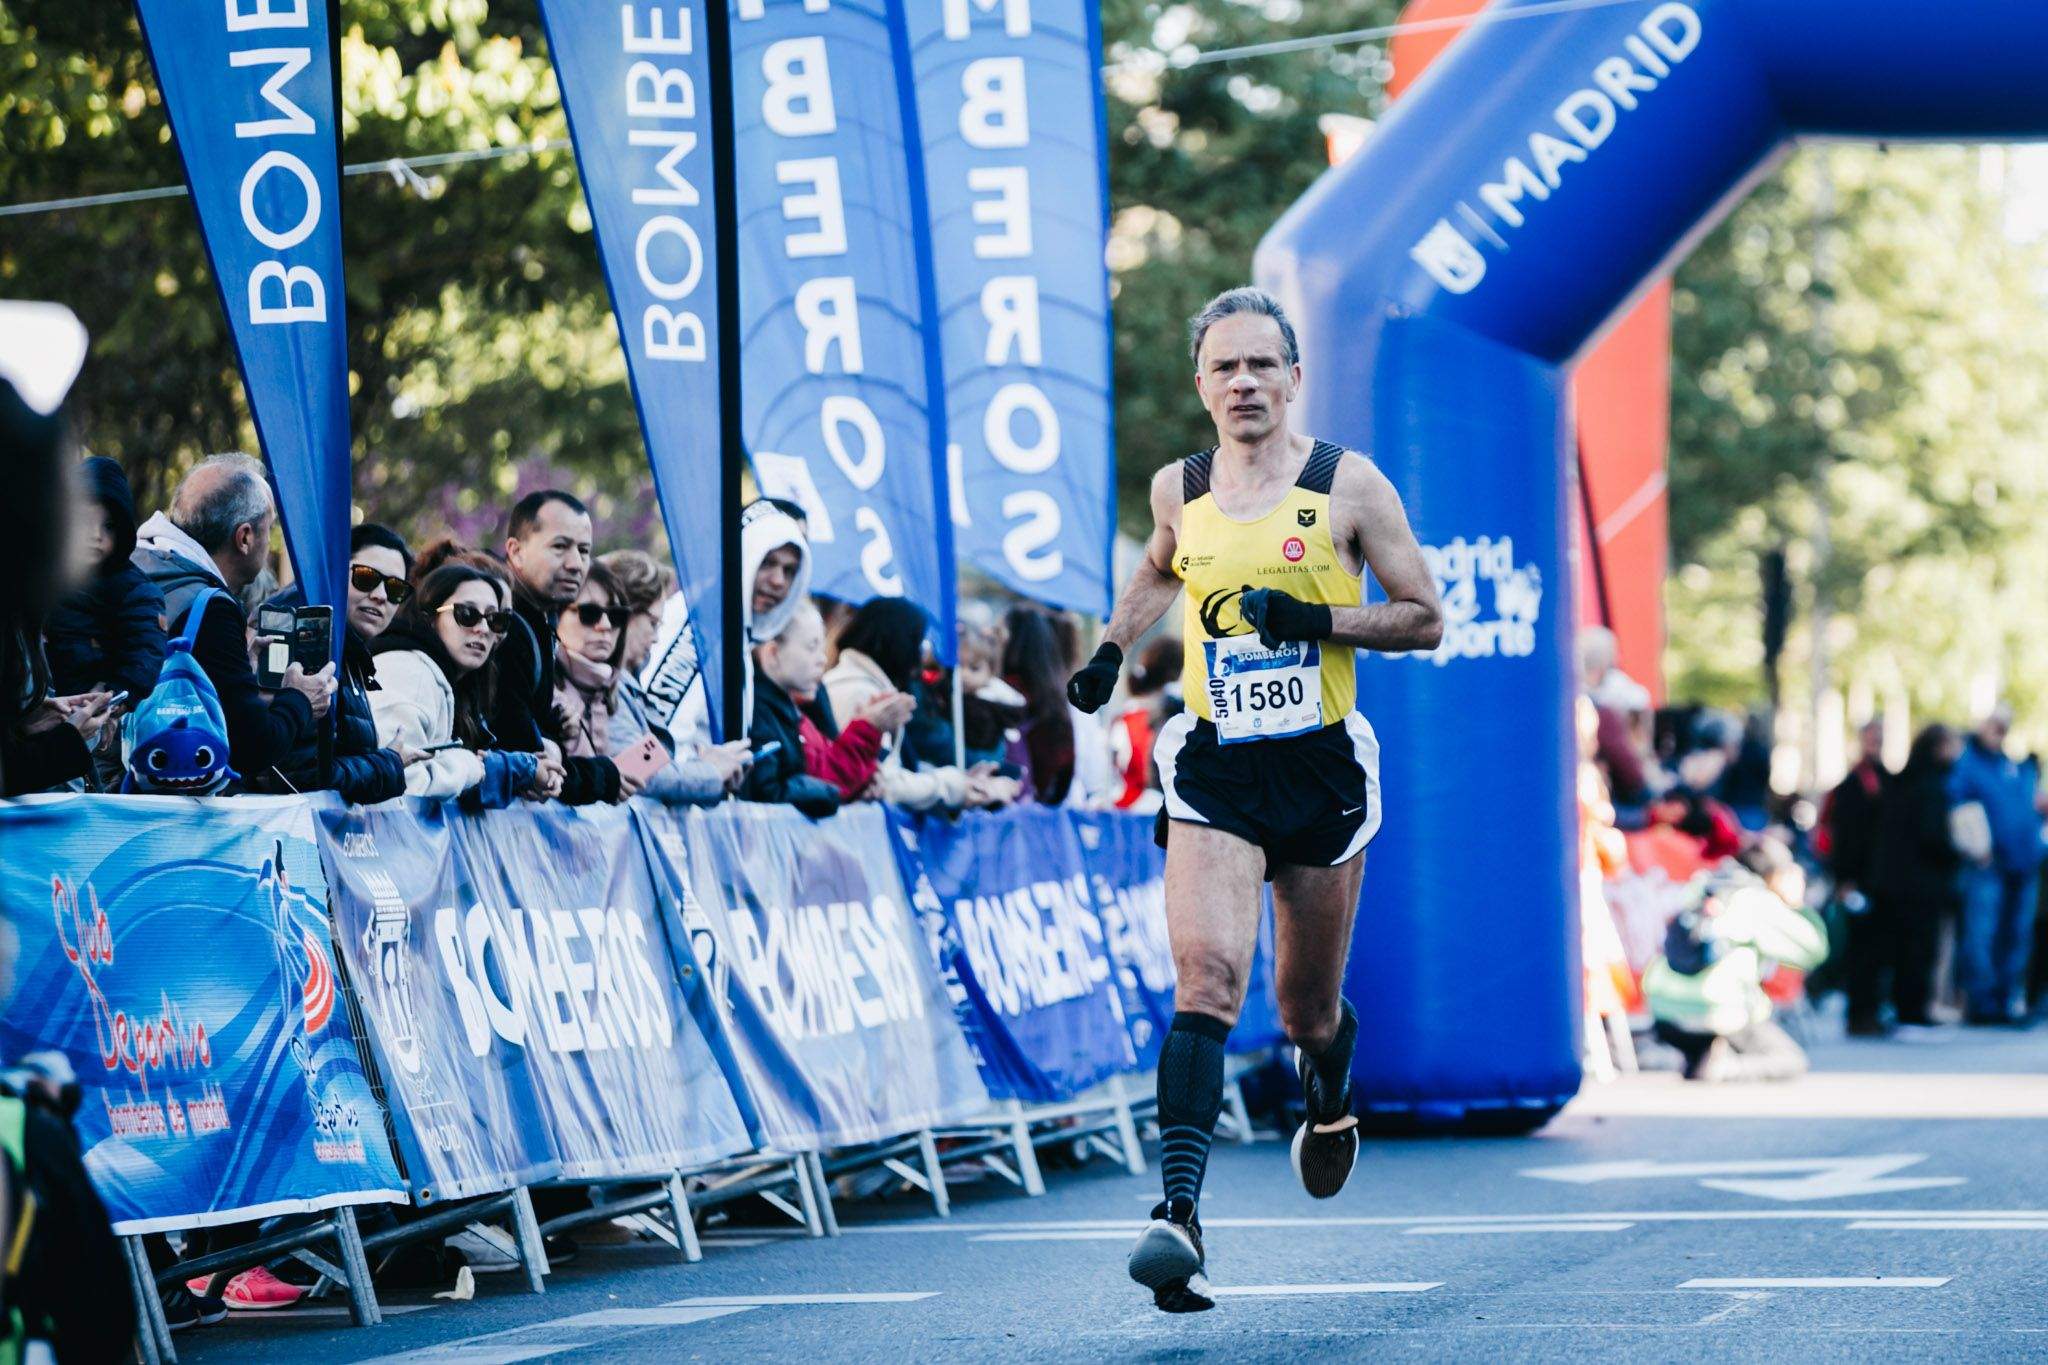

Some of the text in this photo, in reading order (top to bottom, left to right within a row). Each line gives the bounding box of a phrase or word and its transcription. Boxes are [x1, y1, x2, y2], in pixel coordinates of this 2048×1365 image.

[1478, 2, 1703, 229] MADRID
[621, 3, 706, 363] BOMBE
[1256, 564, 1330, 575] LEGALITAS.COM
[1230, 676, 1304, 713] 1580
[1237, 647, 1298, 662] BOMBEROS
[434, 901, 673, 1057] BOMBEROS
